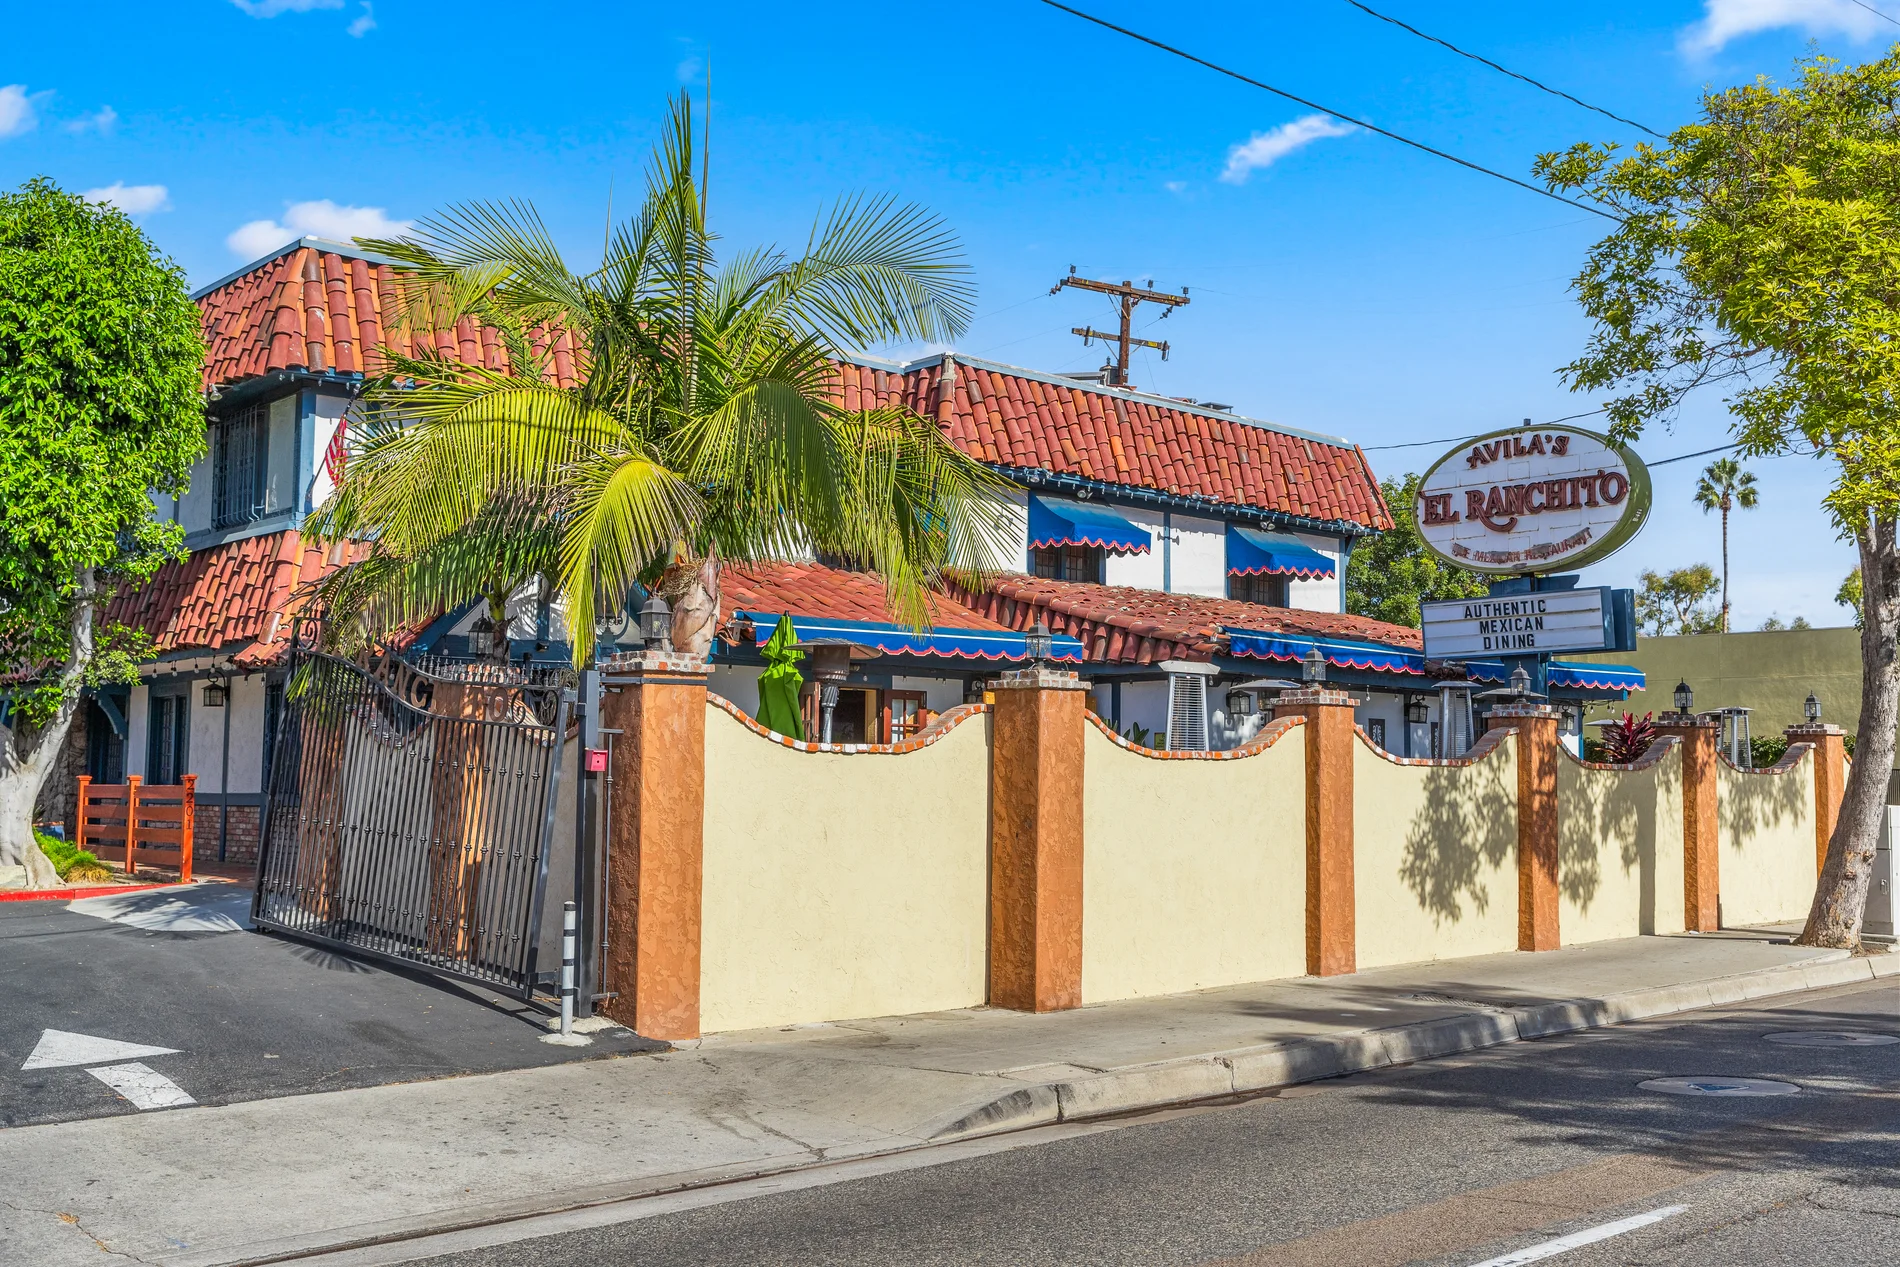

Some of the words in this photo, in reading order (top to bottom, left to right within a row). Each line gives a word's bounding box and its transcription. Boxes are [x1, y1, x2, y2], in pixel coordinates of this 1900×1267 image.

[1466, 433, 1570, 469] AVILA'S
[1418, 490, 1460, 525] EL
[1465, 469, 1629, 532] RANCHITO
[1473, 550, 1520, 564] MEXAN
[1464, 599, 1546, 619] AUTHENTIC
[1480, 616, 1544, 634] MEXICAN
[1483, 633, 1535, 650] DINING
[185, 779, 195, 830] 2201
